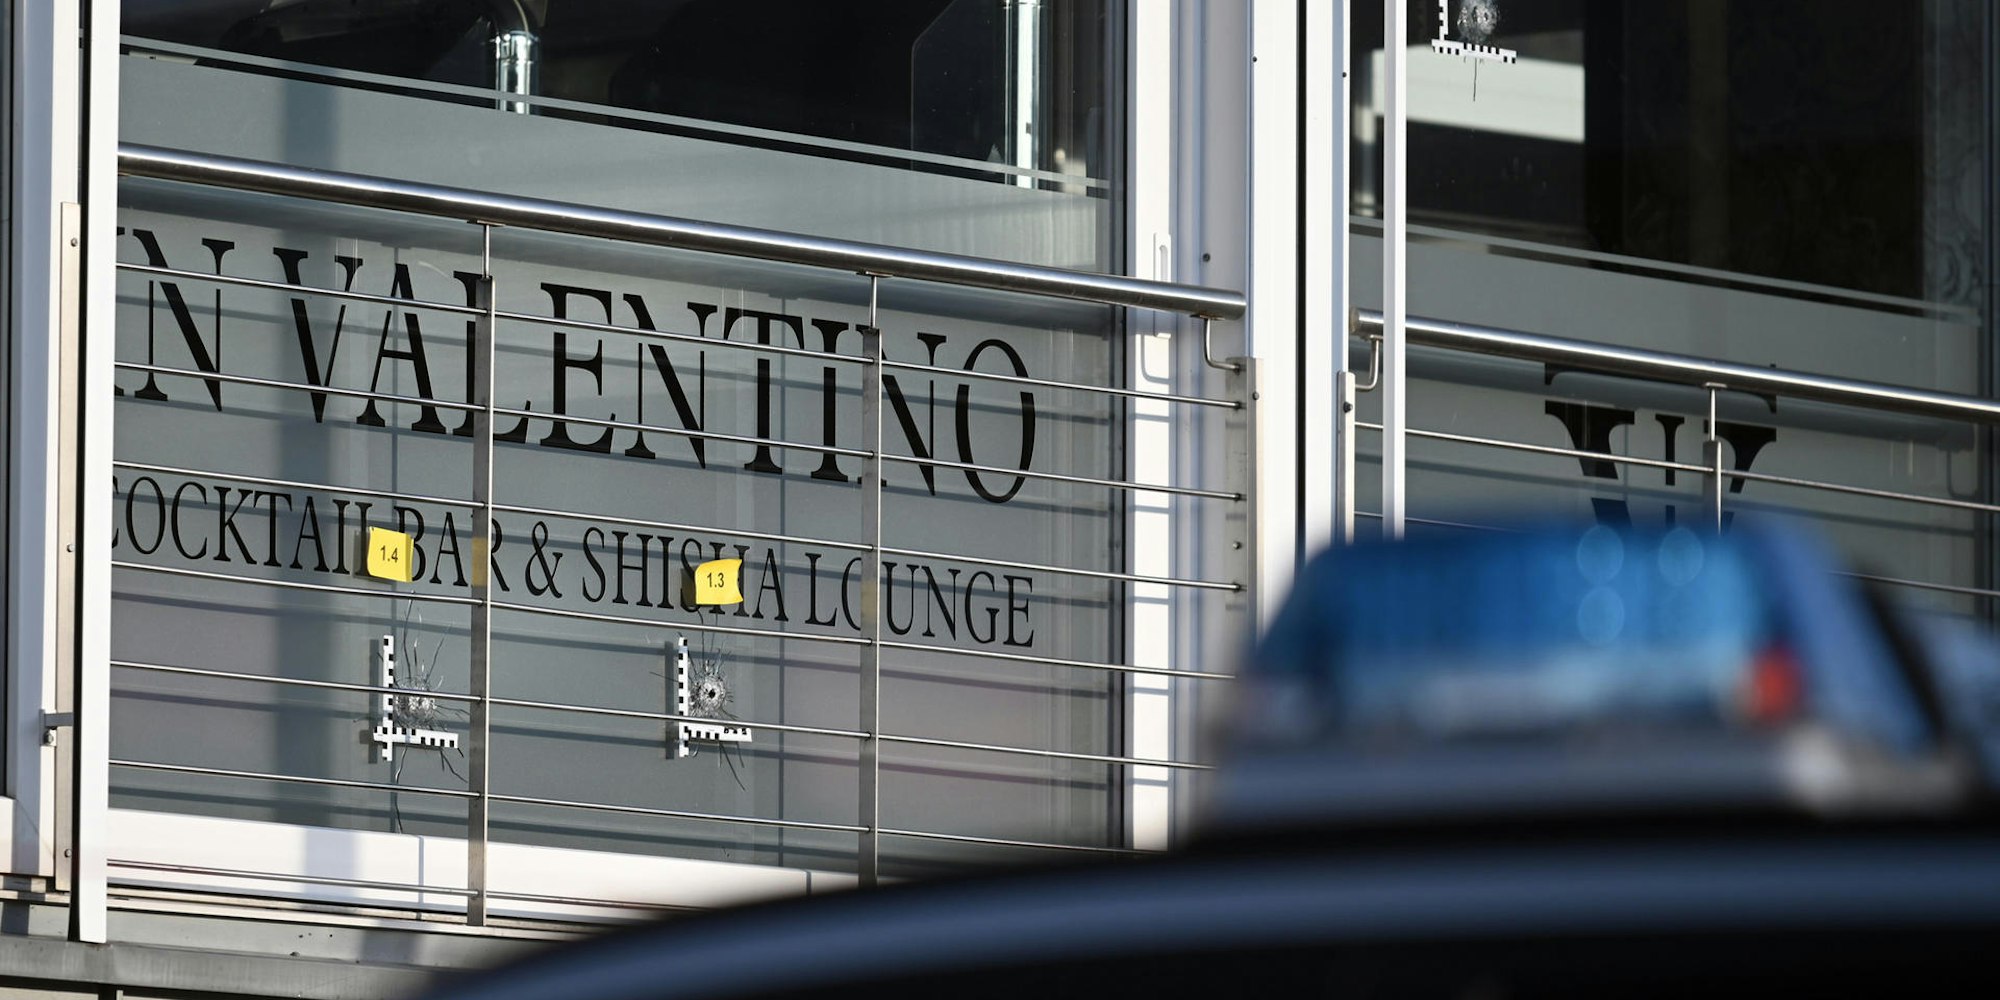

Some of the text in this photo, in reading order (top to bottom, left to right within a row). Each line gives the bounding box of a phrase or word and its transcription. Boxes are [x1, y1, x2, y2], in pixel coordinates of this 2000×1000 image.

[116, 227, 1036, 503] N VALENTINO
[112, 475, 376, 578] OCKTAIL
[524, 520, 563, 599] &
[379, 544, 399, 564] 1.4
[706, 572, 725, 589] 1.3
